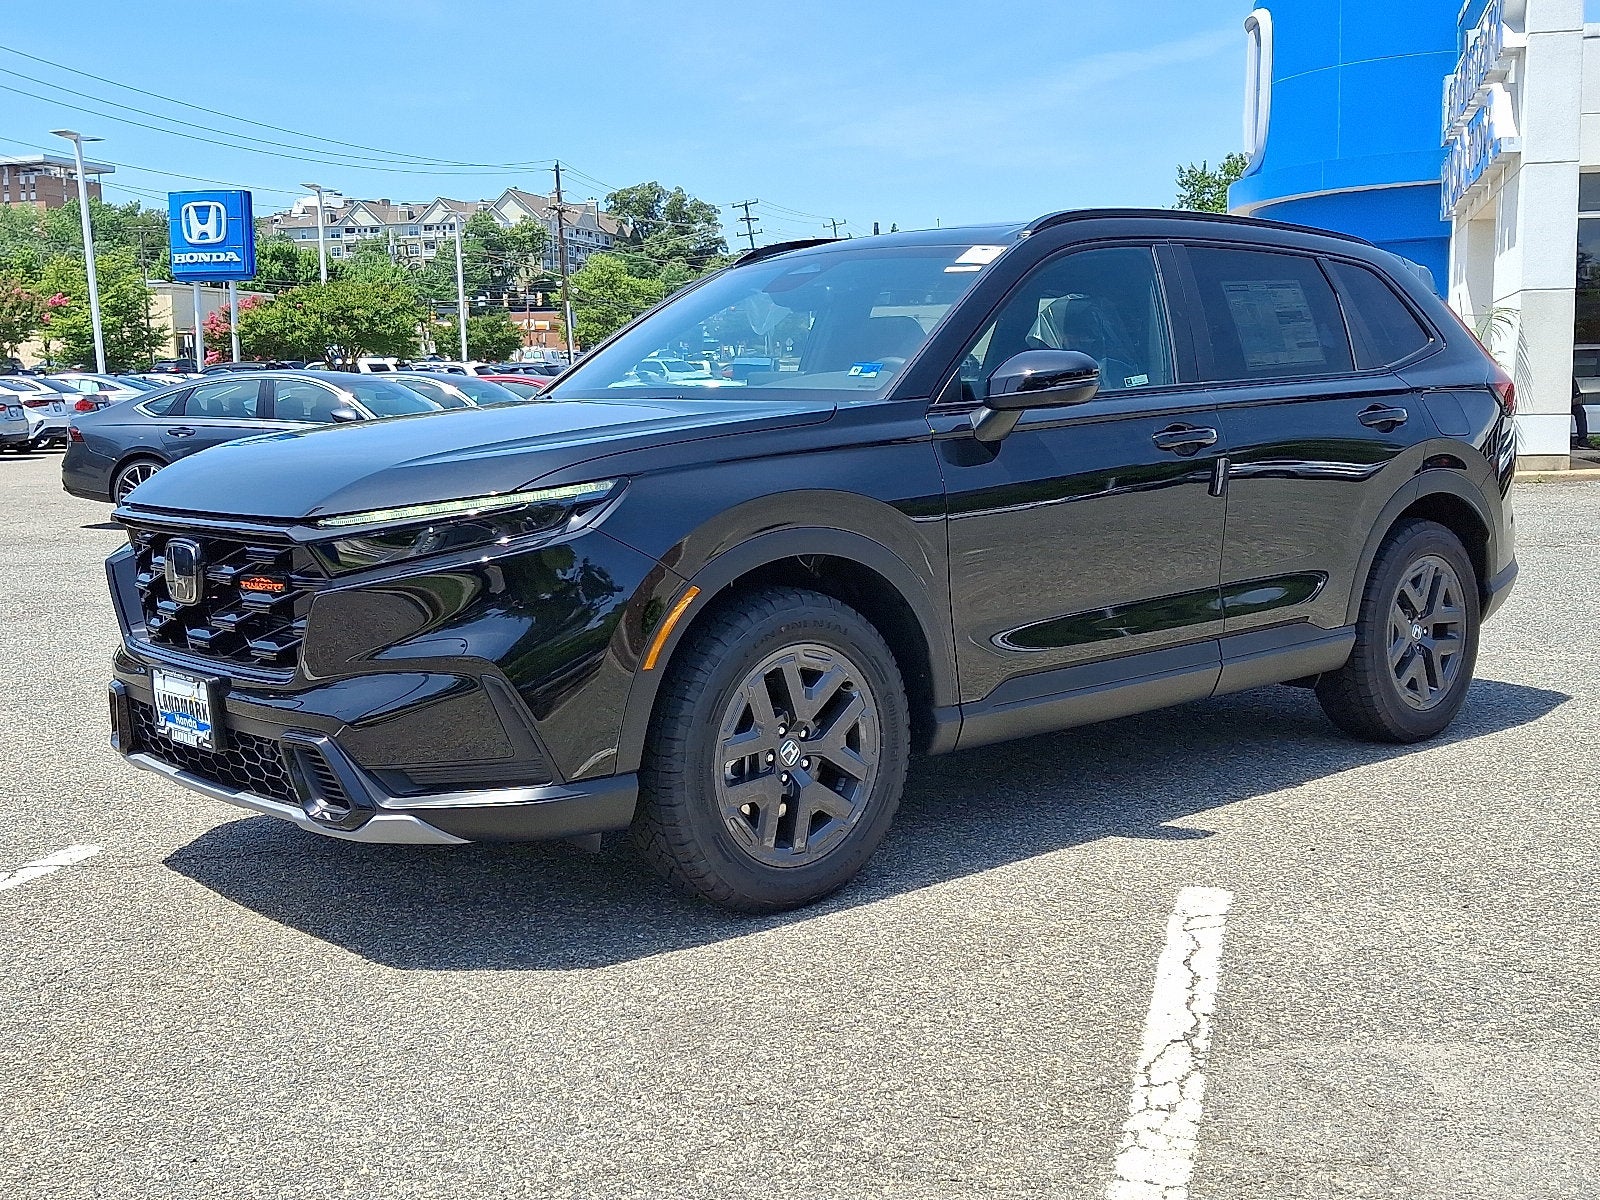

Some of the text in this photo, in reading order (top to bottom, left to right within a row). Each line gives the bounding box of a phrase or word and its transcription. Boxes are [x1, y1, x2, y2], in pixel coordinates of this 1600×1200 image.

[173, 251, 241, 264] HONDA
[157, 691, 209, 722] LANDMARK
[174, 714, 198, 729] Honda
